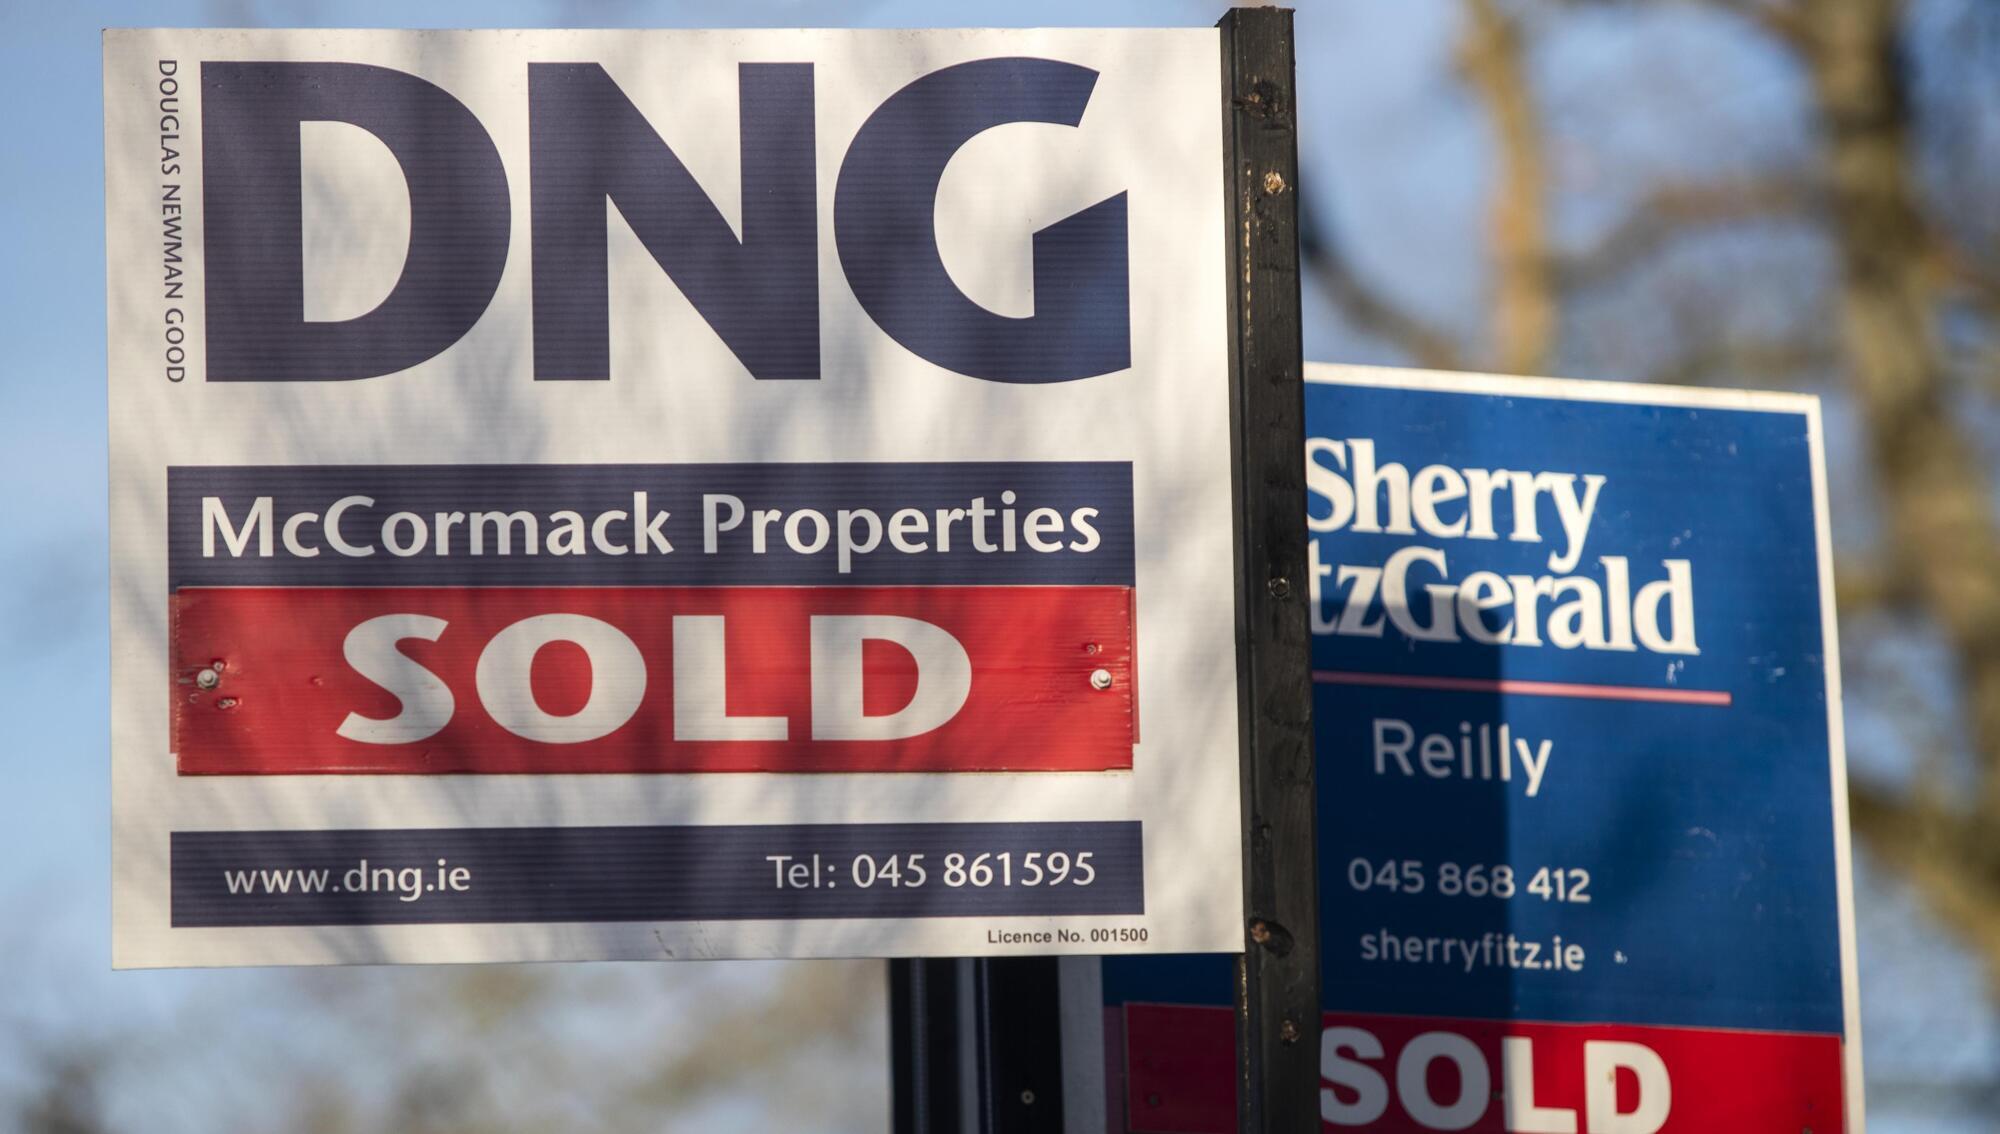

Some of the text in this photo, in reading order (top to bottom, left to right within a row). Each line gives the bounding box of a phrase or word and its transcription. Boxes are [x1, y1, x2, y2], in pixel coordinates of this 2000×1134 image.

[158, 59, 185, 383] DOUGLAS NEWMAN GOOD
[199, 56, 1132, 384] DNG
[201, 490, 1101, 574] McCormack Properties
[1306, 437, 1607, 574] Sherry
[1309, 539, 1700, 657] tzGerald
[336, 613, 972, 745] SOLD
[1374, 718, 1554, 798] Reilly
[224, 851, 1095, 903] www.dng.ie Tel: 045 861595
[1348, 857, 1592, 904] 045 868 412
[987, 927, 1148, 944] Licence No. 001500
[1360, 929, 1586, 973] sherryfitz.ie
[1320, 1026, 1672, 1134] SOLD
